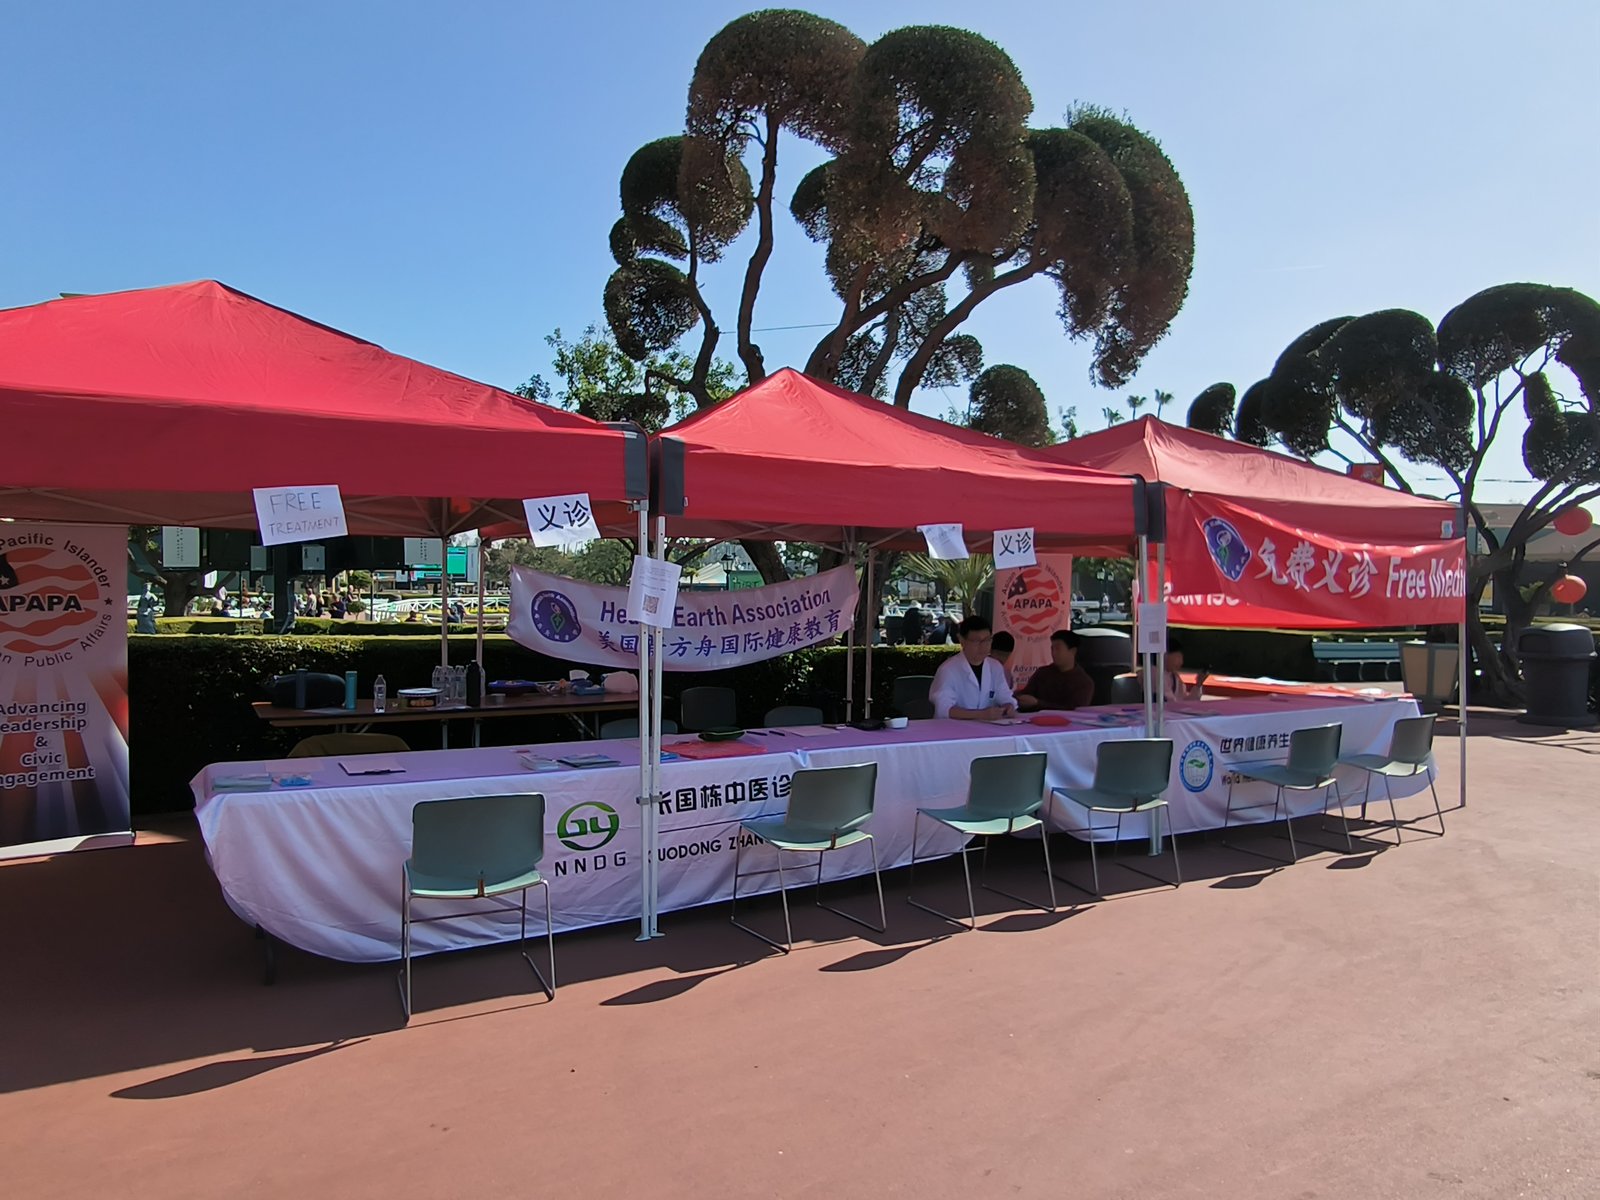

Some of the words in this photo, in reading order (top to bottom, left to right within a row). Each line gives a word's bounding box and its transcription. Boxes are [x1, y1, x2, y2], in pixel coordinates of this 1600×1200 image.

[269, 492, 321, 515] FREE
[537, 500, 590, 532] 义诊
[268, 516, 339, 536] TREATMENT
[999, 531, 1032, 556] 义诊
[63, 540, 111, 588] Islander
[1254, 537, 1379, 600] 免费义诊
[1386, 555, 1426, 599] Free
[1429, 557, 1467, 598] Medi
[674, 605, 728, 627] Earth
[732, 590, 831, 625] Association
[1013, 599, 1053, 609] APAPA
[24, 651, 73, 667] Public
[80, 613, 112, 651] Affairs
[0, 700, 87, 715] Advancing
[0, 717, 87, 732] eadership
[35, 736, 48, 747] &
[21, 752, 62, 765] Civic
[648, 840, 722, 863] UODONG
[728, 833, 766, 850] ZHAN
[555, 851, 627, 877] NNDG
